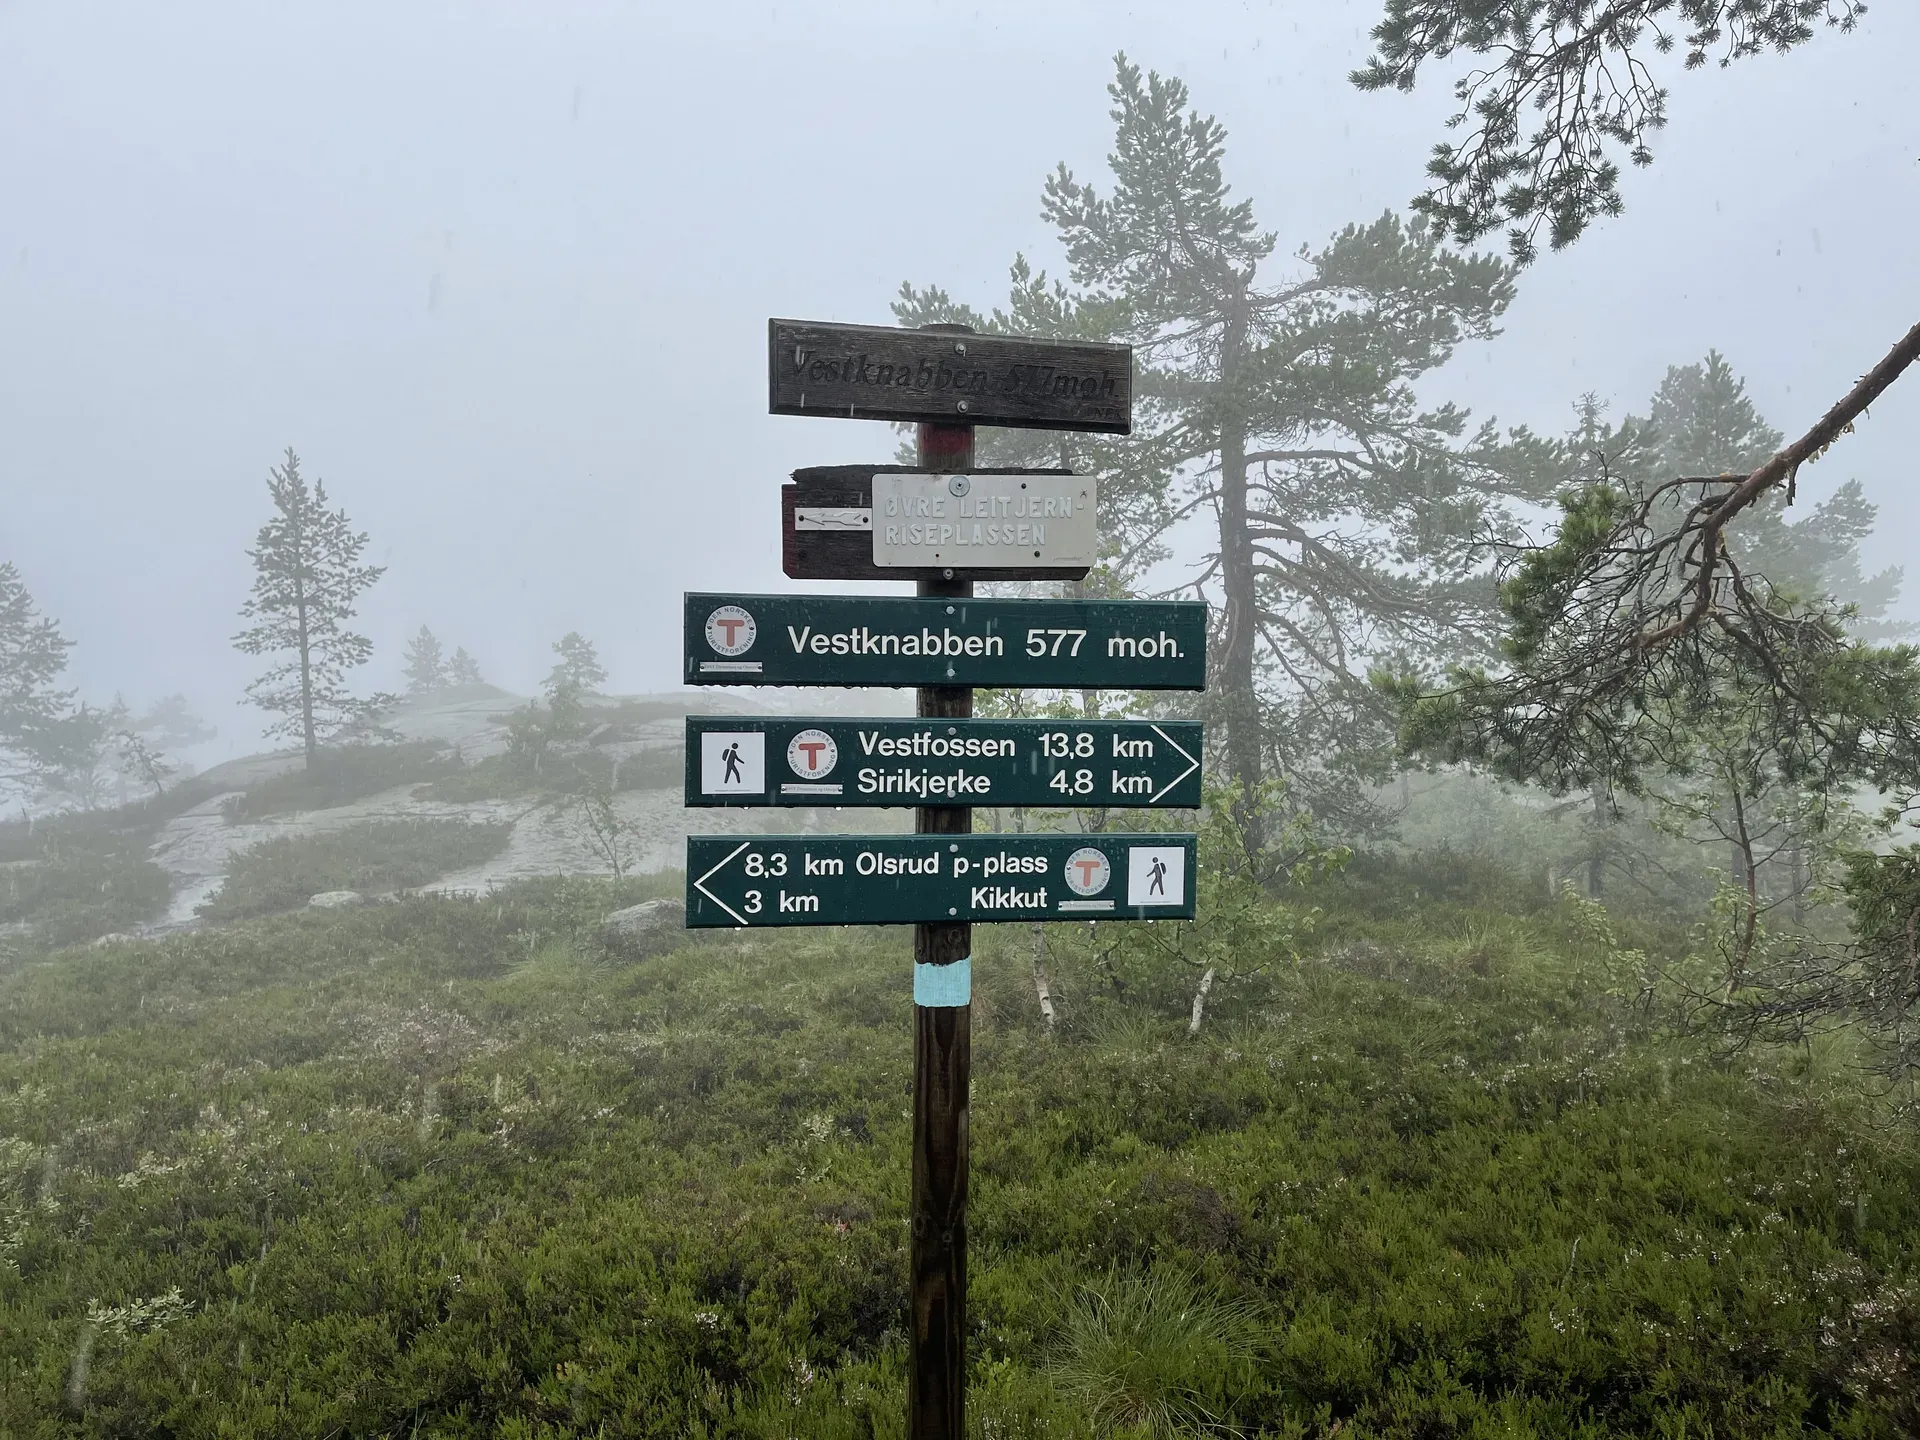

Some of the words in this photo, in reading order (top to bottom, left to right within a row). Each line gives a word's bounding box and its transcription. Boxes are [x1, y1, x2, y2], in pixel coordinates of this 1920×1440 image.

[791, 350, 988, 391] Vestknabben
[884, 495, 946, 519] ØVRE
[959, 495, 1085, 520] LEITJERN-
[885, 523, 1046, 546] RISEPLASSEN
[709, 610, 722, 624] DEN
[724, 607, 753, 625] NORSKE
[707, 631, 755, 655] TURISTFORENING
[716, 619, 745, 647] T
[788, 625, 1004, 656] Vestknabben
[1025, 629, 1087, 657] 577
[1107, 631, 1185, 658] moh.
[790, 734, 804, 748] DEN
[805, 731, 834, 747] NORSKE
[858, 731, 1016, 757] Vestfossen
[1038, 733, 1094, 759] 13,8
[1112, 734, 1153, 758] km
[789, 754, 836, 778] TURISTFORENING
[798, 743, 827, 771] T
[857, 768, 991, 798] Sirikjerke
[1049, 769, 1094, 796] 4,8
[1112, 770, 1152, 794] km
[744, 853, 788, 878] 8,3
[804, 853, 844, 876] km
[855, 852, 940, 876] Olsrud
[1069, 852, 1081, 865] DEN
[1082, 849, 1108, 865] NORSKE
[1066, 872, 1109, 894] TURISTFORENING
[1075, 861, 1101, 887] T
[744, 890, 763, 914] 3
[779, 890, 819, 913] km
[971, 887, 1048, 909] Kikkut
